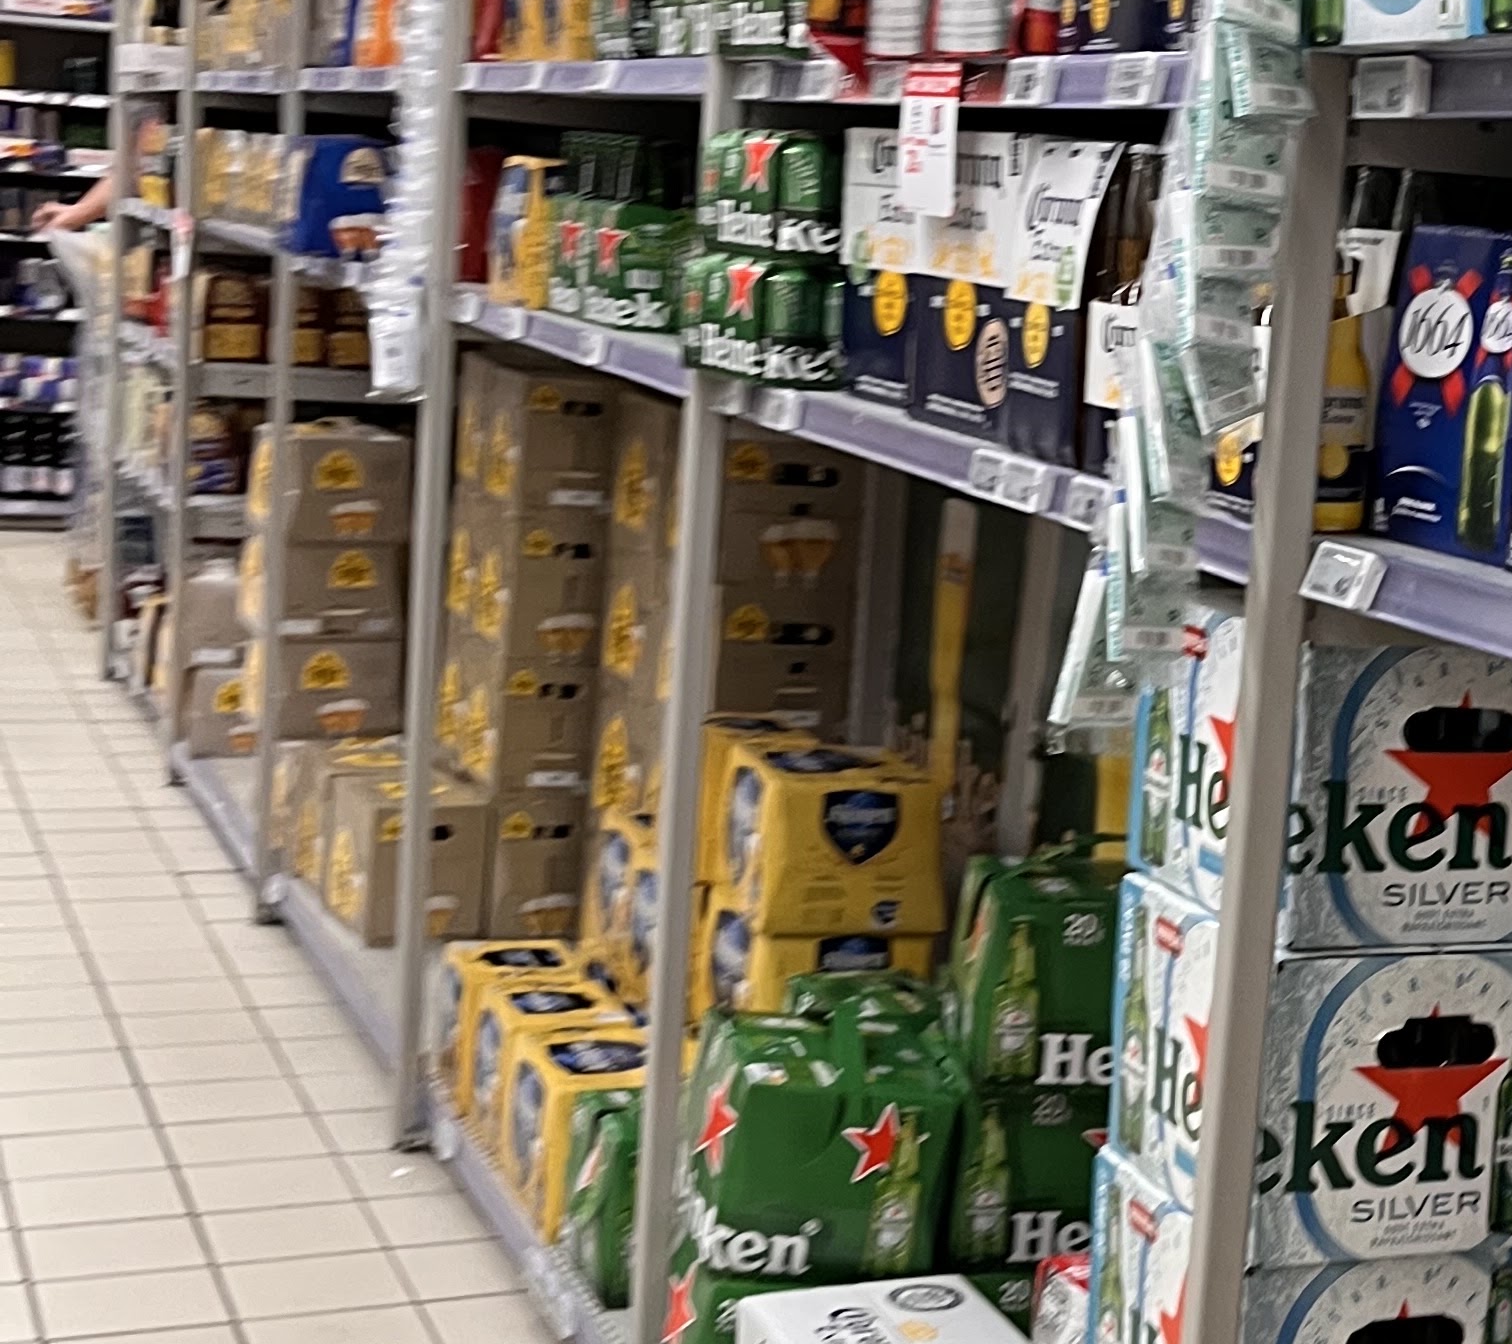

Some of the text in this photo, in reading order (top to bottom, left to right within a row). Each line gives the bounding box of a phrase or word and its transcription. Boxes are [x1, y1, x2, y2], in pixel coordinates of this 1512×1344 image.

[1401, 301, 1470, 357] 1664
[1383, 881, 1511, 907] SILVER
[1352, 1191, 1481, 1223] SILVER
